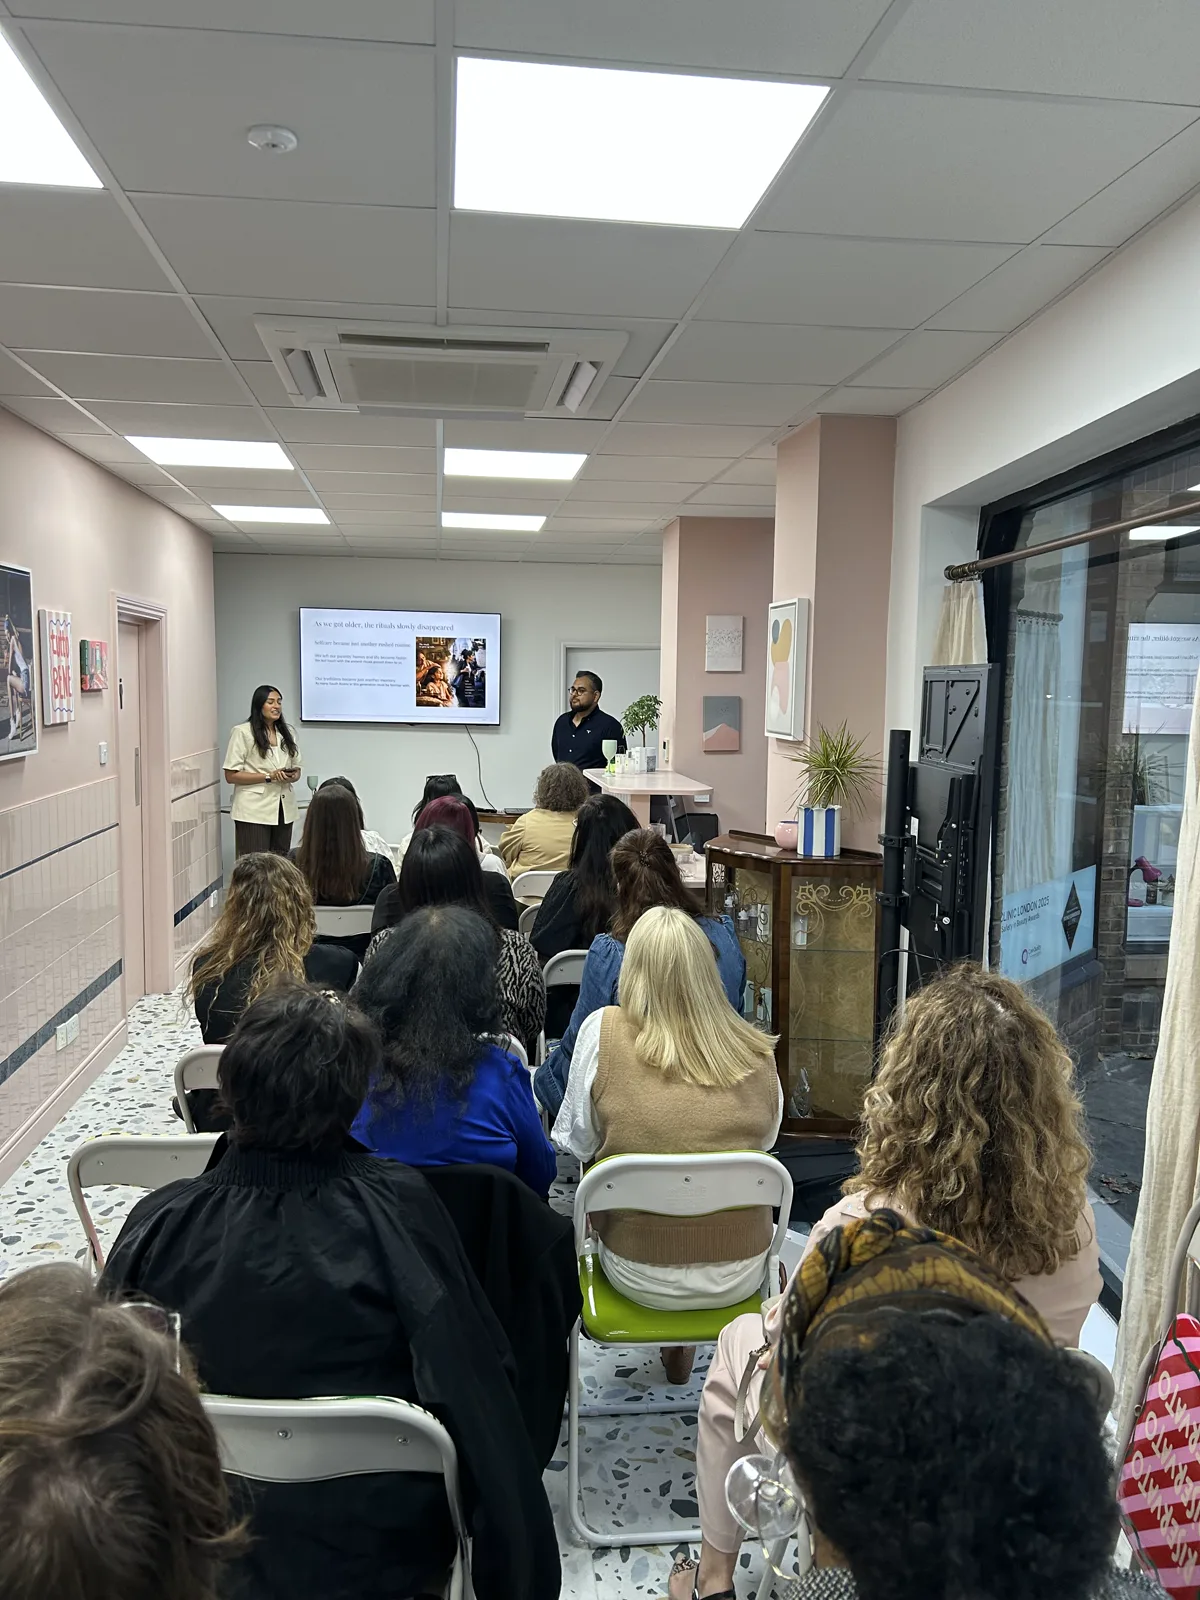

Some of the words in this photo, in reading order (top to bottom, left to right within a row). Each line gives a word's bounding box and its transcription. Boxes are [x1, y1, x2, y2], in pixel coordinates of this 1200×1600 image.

[53, 665, 72, 699] BENE
[1017, 900, 1038, 916] LONDON
[1038, 896, 1049, 908] 2025
